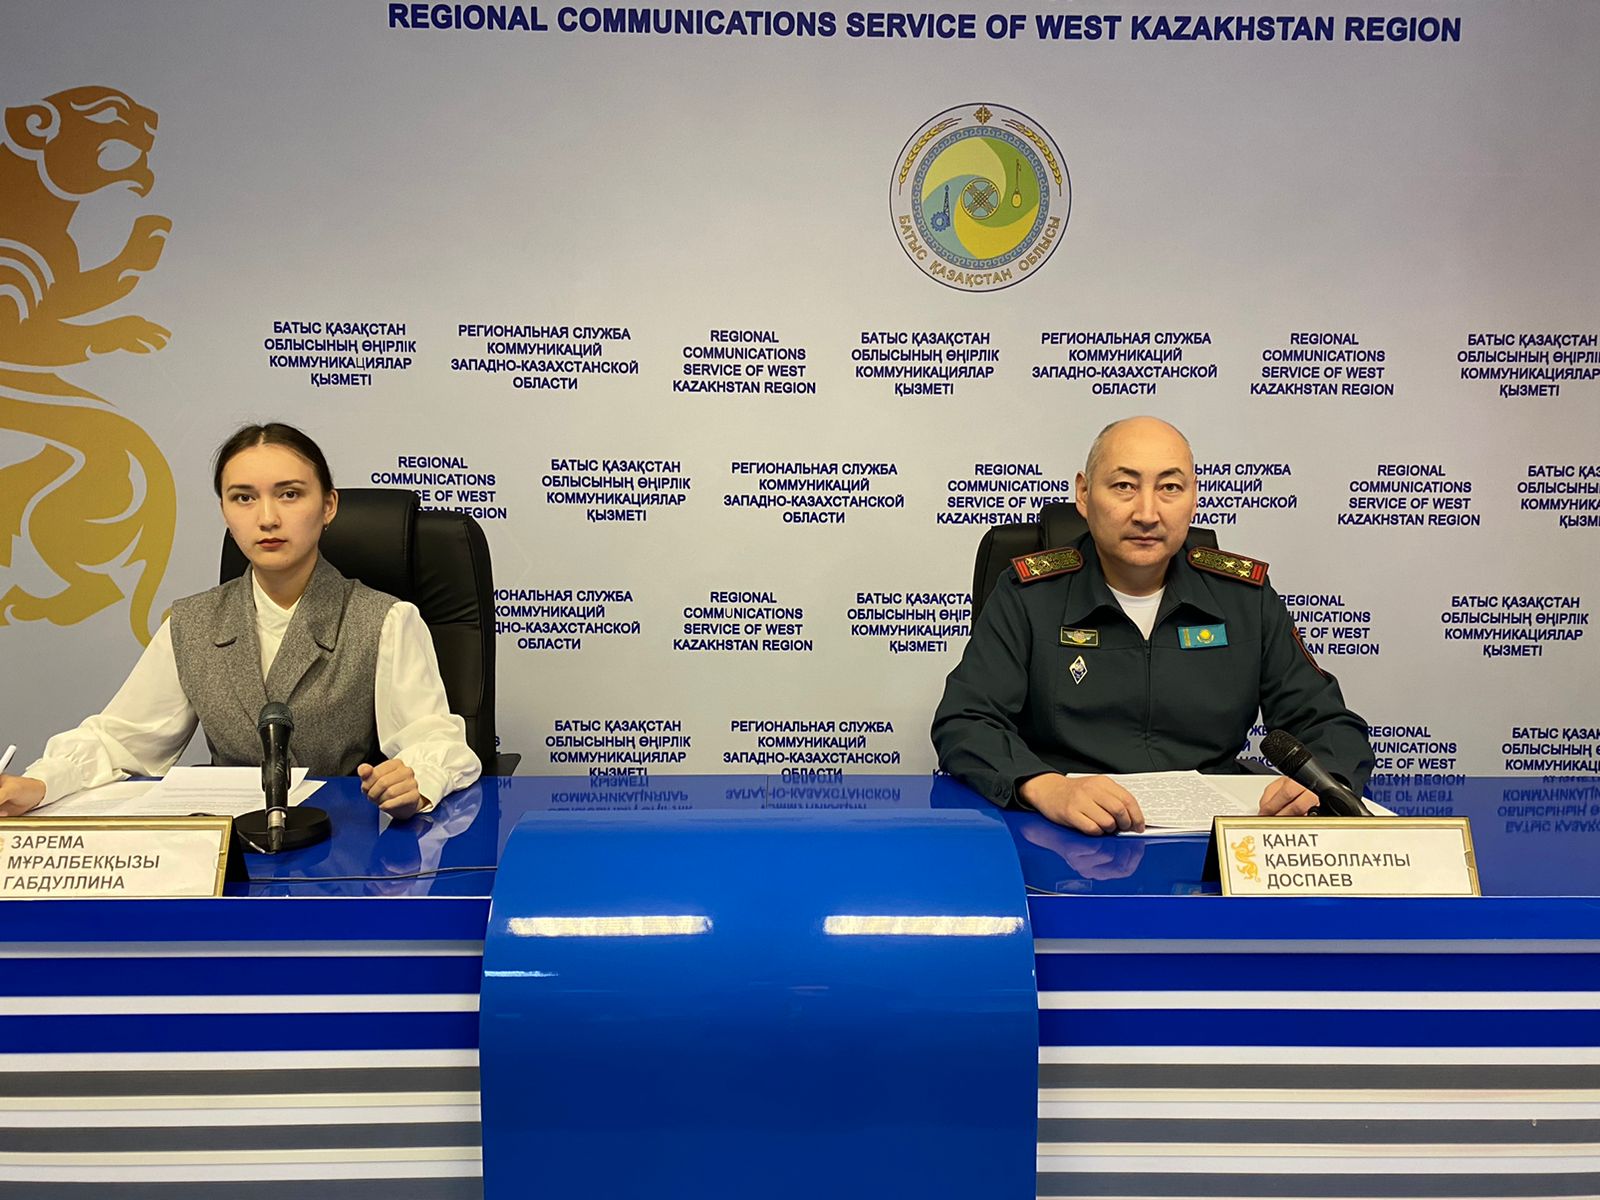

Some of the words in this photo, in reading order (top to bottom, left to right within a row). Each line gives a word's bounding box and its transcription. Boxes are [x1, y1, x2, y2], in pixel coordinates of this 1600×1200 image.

[388, 2, 549, 32] REGIONAL
[557, 6, 837, 38] COMMUNICATIONS
[845, 11, 977, 39] SERVICE
[985, 13, 1027, 40] OF
[1034, 14, 1123, 41] WEST
[1130, 15, 1335, 42] KAZAKHSTAN
[1344, 16, 1462, 43] REGION
[898, 214, 928, 260] БАТЫС
[929, 260, 1013, 287] ҚАЗАҚСТАН
[1018, 215, 1061, 272] ОБЛЫСЫ
[273, 320, 323, 335] БАТЫС
[325, 321, 406, 338] ҚАЗАҚСТАН
[458, 324, 570, 339] РЕГИОНАЛЬНАЯ
[572, 326, 632, 341] СЛУЖБА
[710, 329, 780, 344] REGIONAL
[860, 331, 909, 345] БАТЫС
[911, 331, 991, 348] ҚАЗАҚСТАН
[1041, 331, 1151, 345] РЕГИОНАЛЬНАЯ
[1153, 332, 1212, 345] СЛУЖБА
[1290, 332, 1360, 346] REGIONAL
[1467, 333, 1516, 347] БАТЫС
[1518, 333, 1599, 350] ҚАЗАҚСТАН
[263, 337, 359, 355] ОБЛЫСЫНЫҢ
[361, 339, 417, 355] ӨҢІРЛІК
[486, 341, 603, 359] КОММУНИКАЦИЙ
[682, 346, 807, 361] COMMUNICATIONS
[269, 354, 413, 371] КОММУНИКАЦИЯЛАР
[851, 348, 943, 365] ОБЛЫСЫНЫҢ
[945, 348, 1000, 365] ӨҢІРЛІК
[1068, 346, 1183, 365] КОММУНИКАЦИЙ
[1262, 349, 1386, 363] COMMUNICATIONS
[1456, 350, 1550, 366] ОБЛЫСЫНЫҢ
[1552, 350, 1600, 366] ӨҢІРЛІ
[450, 358, 639, 375] ЗАПАДНО-КАЗАХСТАНСКОЙ
[682, 363, 743, 377] SERVICE
[744, 364, 765, 377] OF
[766, 364, 807, 378] WEST
[855, 365, 995, 380] КОММУНИКАЦИЯЛАР
[1031, 363, 1218, 381] ЗАПАДНО-КАЗАХСТАНСКОЙ
[1261, 365, 1321, 379] SERVICE
[1323, 366, 1343, 379] OF
[1345, 366, 1386, 380] WEST
[310, 372, 372, 387] ҚЫЗМЕТІ
[1460, 366, 1600, 383] КОММУНИКАЦИЯЛАР
[512, 376, 578, 390] ОБЛАСТИ
[672, 379, 761, 394] KAZAKHSTAN
[763, 381, 817, 395] REGION
[894, 382, 954, 398] ҚЫЗМЕТІ
[1091, 382, 1157, 395] ОБЛАСТИ
[1250, 382, 1339, 396] KAZAKHSTAN
[1341, 383, 1395, 396] REGION
[1499, 383, 1560, 399] ҚЫЗМЕТІ
[397, 455, 469, 470] REGIONAL
[550, 458, 599, 472] БАТЫС
[602, 459, 681, 475] ҚАЗАҚСТАН
[731, 461, 839, 476] РЕГИОНАЛЬНАЯ
[841, 462, 898, 476] СЛУЖБА
[974, 463, 1044, 476] REGIONAL
[1234, 463, 1292, 476] СЛУЖБА
[1377, 464, 1447, 477] REGIONAL
[1527, 464, 1576, 478] БАТЫС
[370, 472, 496, 487] COMMUNICATIONS
[541, 474, 635, 492] ОБЛЫСЫНЫҢ
[637, 476, 692, 492] ӨҢІРЛІК
[758, 477, 870, 494] КОММУНИКАЦИЙ
[947, 479, 1070, 493] COMMUNICATIONS
[1197, 478, 1262, 494] НИКАЦИЙ
[1349, 480, 1472, 494] COMMUNICATIONS
[1516, 481, 1600, 495] ОБЛЫСЫНЫ
[435, 490, 453, 501] OF
[457, 490, 496, 502] WEST
[546, 491, 687, 508] КОММУНИКАЦИЯЛАР
[723, 493, 905, 509] ЗАПАДНО-КАЗАХСТАНСКОЙ
[946, 495, 1005, 509] SERVICE
[1008, 497, 1027, 508] OF
[1197, 495, 1297, 508] ЗАХСТАНСКОЙ
[1348, 496, 1408, 510] SERVICE
[1409, 497, 1430, 510] OF
[1432, 497, 1472, 510] WEST
[586, 508, 647, 523] ҚЫЗМЕТІ
[782, 511, 846, 524] ОБЛАСТИ
[936, 512, 1023, 525] KAZAKHSTAN
[1337, 512, 1425, 526] KAZAKHSTAN
[1427, 513, 1481, 527] REGION
[576, 589, 634, 603] СЛУЖБА
[709, 591, 778, 604] REGIONAL
[856, 592, 903, 605] БАТЫС
[1451, 595, 1499, 608] БАТЫС
[1501, 595, 1581, 611] ҚАЗАҚСТАН
[683, 606, 804, 620] COMMUNICATIONS
[846, 608, 937, 624] ОБЛЫСЫНЫҢ
[938, 608, 973, 624] ӨҢІР
[1289, 611, 1371, 623] UNICATIONS
[1440, 611, 1533, 627] ОБЛЫСЫНЫҢ
[1535, 612, 1590, 628] ӨҢІРЛІК
[683, 622, 741, 636] SERVICE
[743, 623, 763, 636] OF
[764, 623, 804, 636] WEST
[851, 623, 972, 639] КОММУНИКАЦИЯЛ
[1309, 626, 1330, 639] OF
[1331, 626, 1371, 640] WEST
[1444, 627, 1584, 644] КОММУНИКАЦИЯЛАР
[517, 637, 581, 650] ОБЛАСТИ
[673, 638, 759, 652] KAZAKHSTAN
[762, 639, 813, 652] REGION
[890, 640, 948, 654] ҚЫЗМЕТІ
[1327, 642, 1380, 656] REGION
[1482, 644, 1543, 659] ҚЫЗМЕТІ
[554, 719, 602, 732] БАТЫС
[604, 719, 682, 735] ҚАЗАҚСТАН
[730, 720, 836, 733] РЕГИОНАЛЬНАЯ
[838, 720, 894, 734] СЛУЖБА
[1511, 726, 1559, 740] БАТЫС
[545, 735, 637, 750] ОБЛЫСЫНЫҢ
[638, 735, 692, 750] ӨҢІРЛІК
[757, 734, 867, 751] КОММУНИКАЦИЙ
[549, 751, 687, 765] КОММУНИКАЦИЯЛАР
[722, 750, 901, 766] ЗАПАДНО-КАЗАХСТАНСКОЙ
[1501, 742, 1593, 759] ОБЛЫСЫНЫҢ
[1395, 757, 1416, 770] OF
[1417, 757, 1457, 770] WEST
[1505, 758, 1600, 774] КОММУНИКАЦ
[11, 835, 85, 849] ЗАРЕМА
[1262, 833, 1319, 850] ҚАНАТ
[7, 855, 160, 872] МҰРАЛБЕКҚЫЗЫ
[1265, 853, 1411, 870] ҚАБИБОЛЛАҰЛЫ
[3, 875, 125, 892] ГАБДУЛЛИНА
[1267, 873, 1353, 890] ДОСПАЕВ
